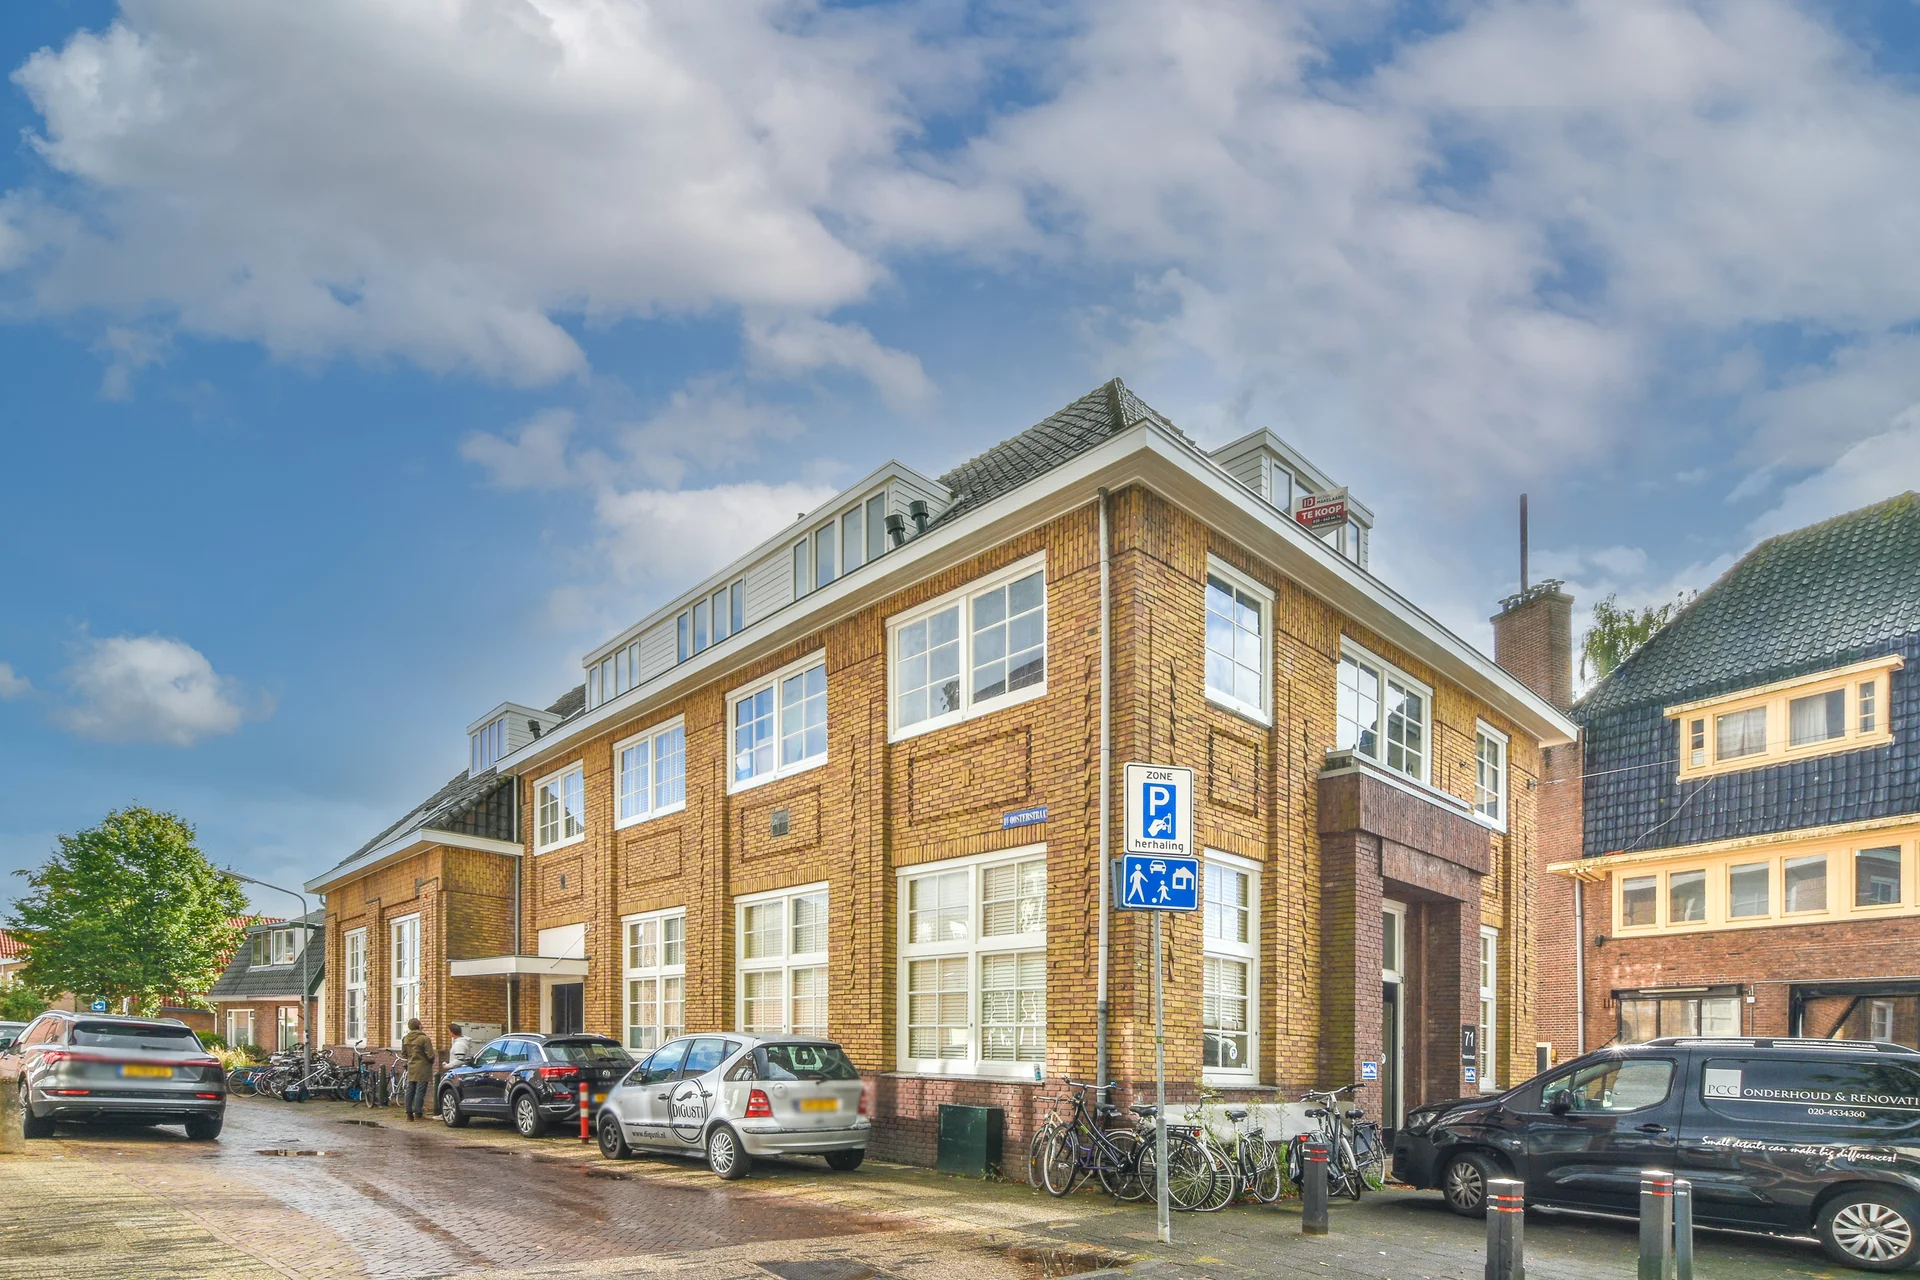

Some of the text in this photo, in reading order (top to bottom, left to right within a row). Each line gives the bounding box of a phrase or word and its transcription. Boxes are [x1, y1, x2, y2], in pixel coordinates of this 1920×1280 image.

[1303, 498, 1314, 507] ID
[1302, 511, 1313, 520] TE
[1315, 505, 1342, 517] KOOP
[1146, 771, 1173, 781] ZONE
[1149, 786, 1170, 816] P
[1135, 839, 1184, 853] herhaling
[1464, 1031, 1474, 1047] 71
[1708, 1084, 1919, 1106] PCC ONDERHOUD & RENOVATI
[1807, 1107, 1866, 1118] 020-4534360
[1701, 1135, 1731, 1147] Small
[1732, 1139, 1766, 1150] details
[1790, 1145, 1816, 1155] make
[1820, 1146, 1834, 1160] big
[1836, 1148, 1897, 1162] differences!
